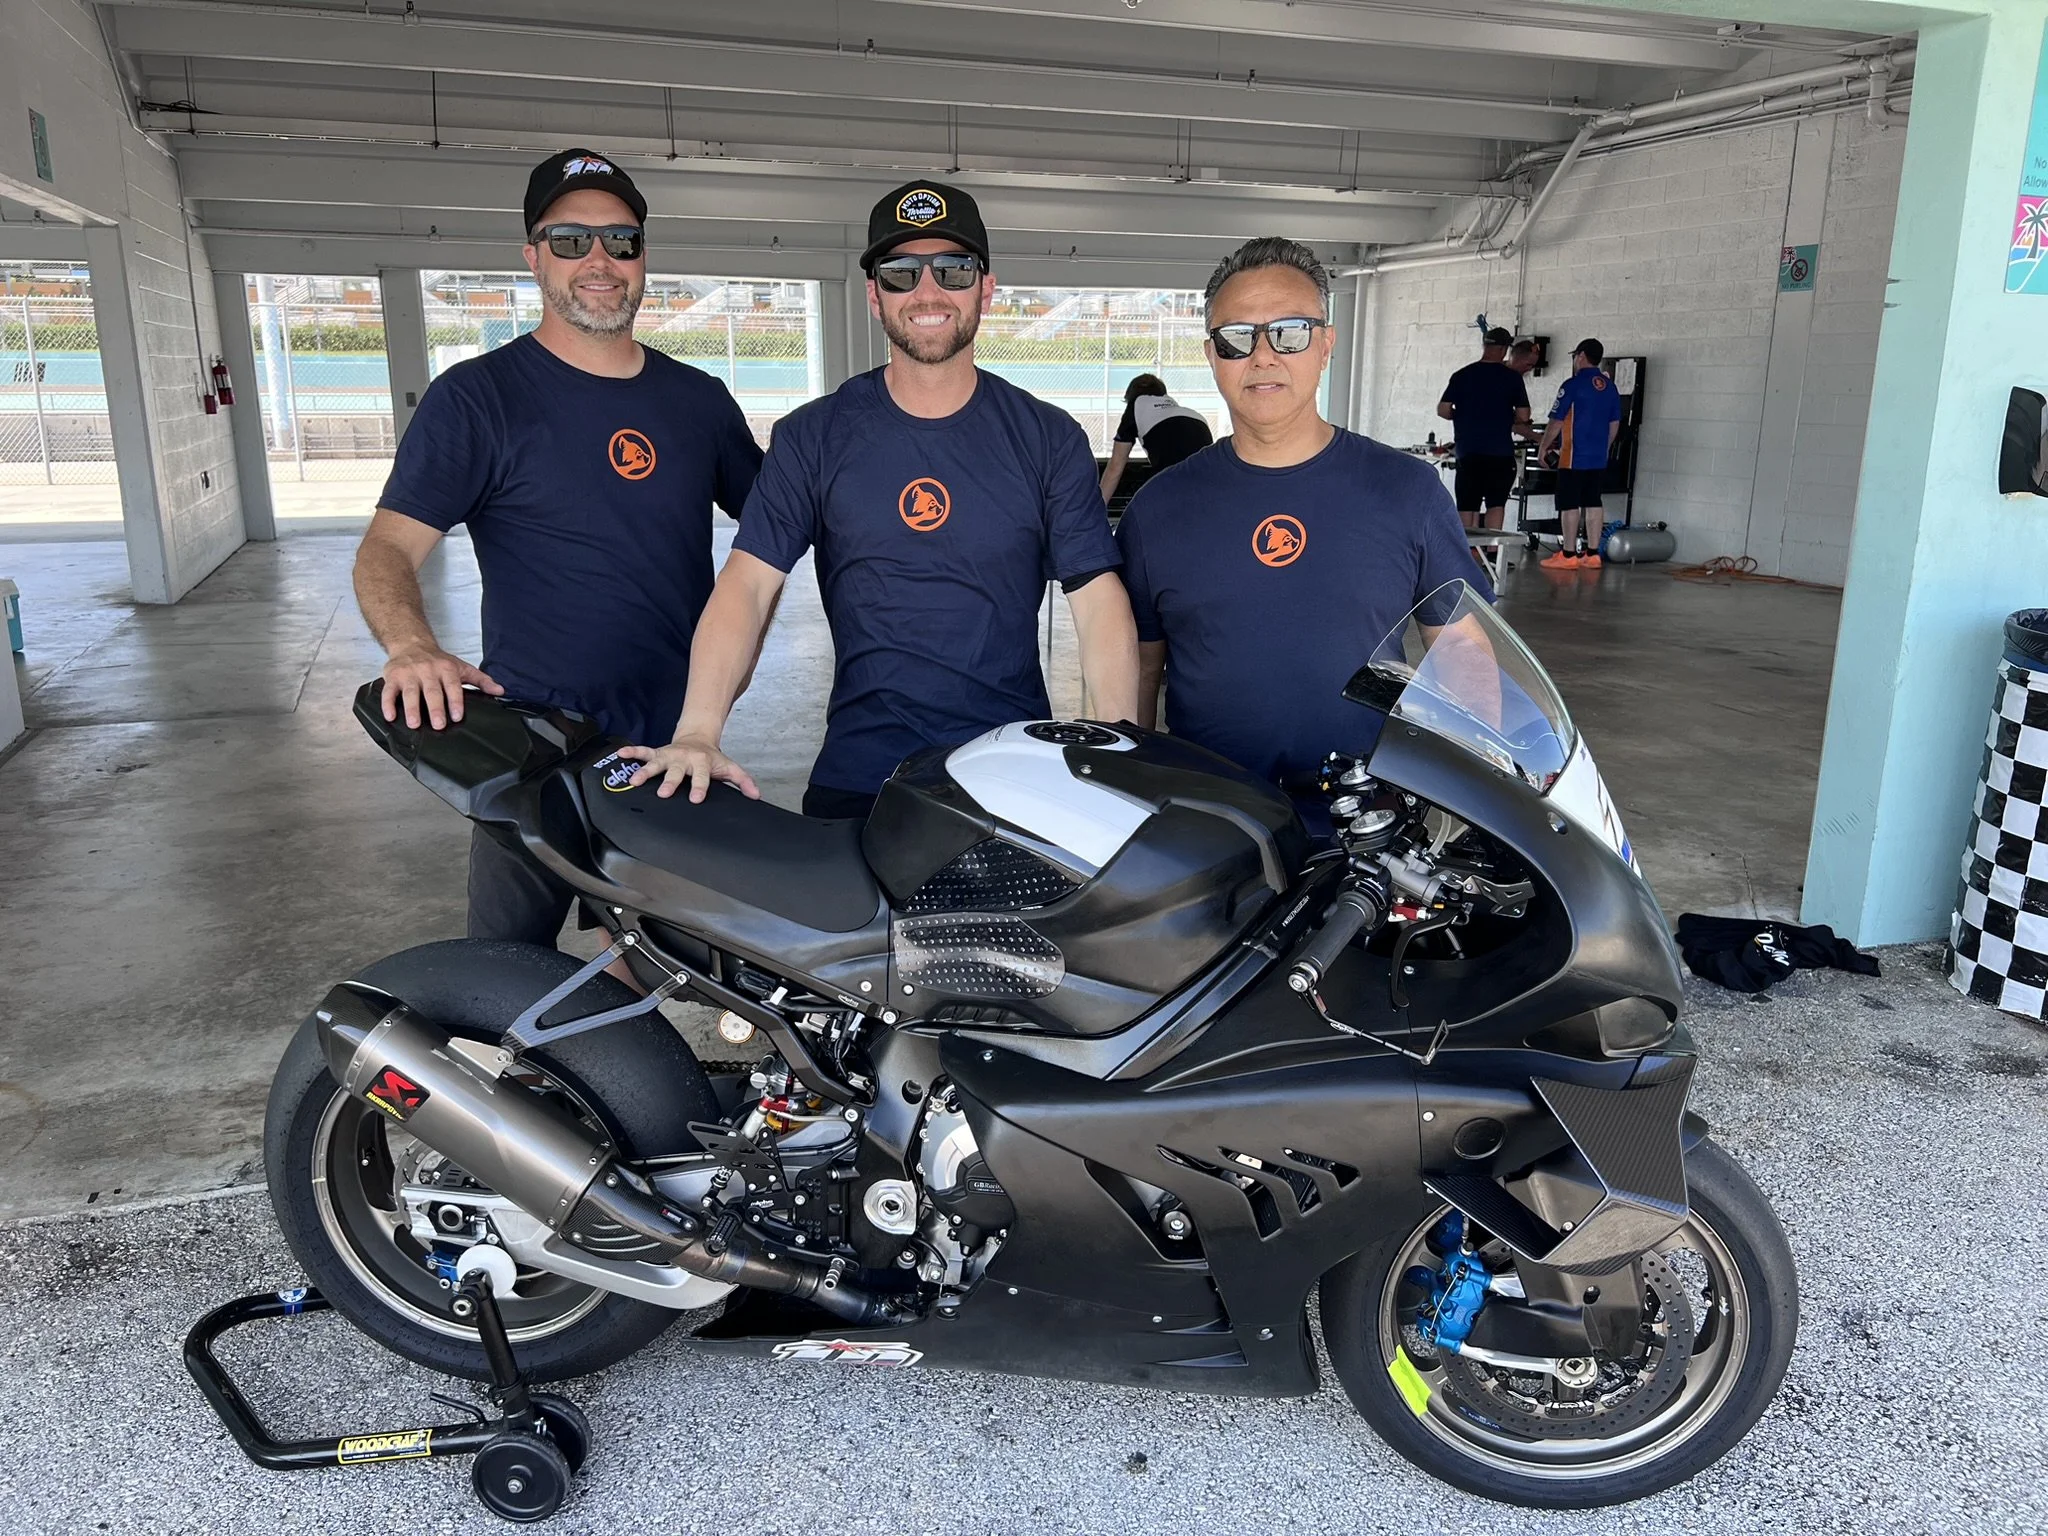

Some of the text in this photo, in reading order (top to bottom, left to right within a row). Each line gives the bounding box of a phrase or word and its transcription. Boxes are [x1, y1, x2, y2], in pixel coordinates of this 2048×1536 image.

[2034, 156, 2047, 169] No
[901, 192, 941, 210] MOTO OPTION
[606, 761, 641, 787] alpha
[344, 1432, 427, 1455] WOODCRAFT
